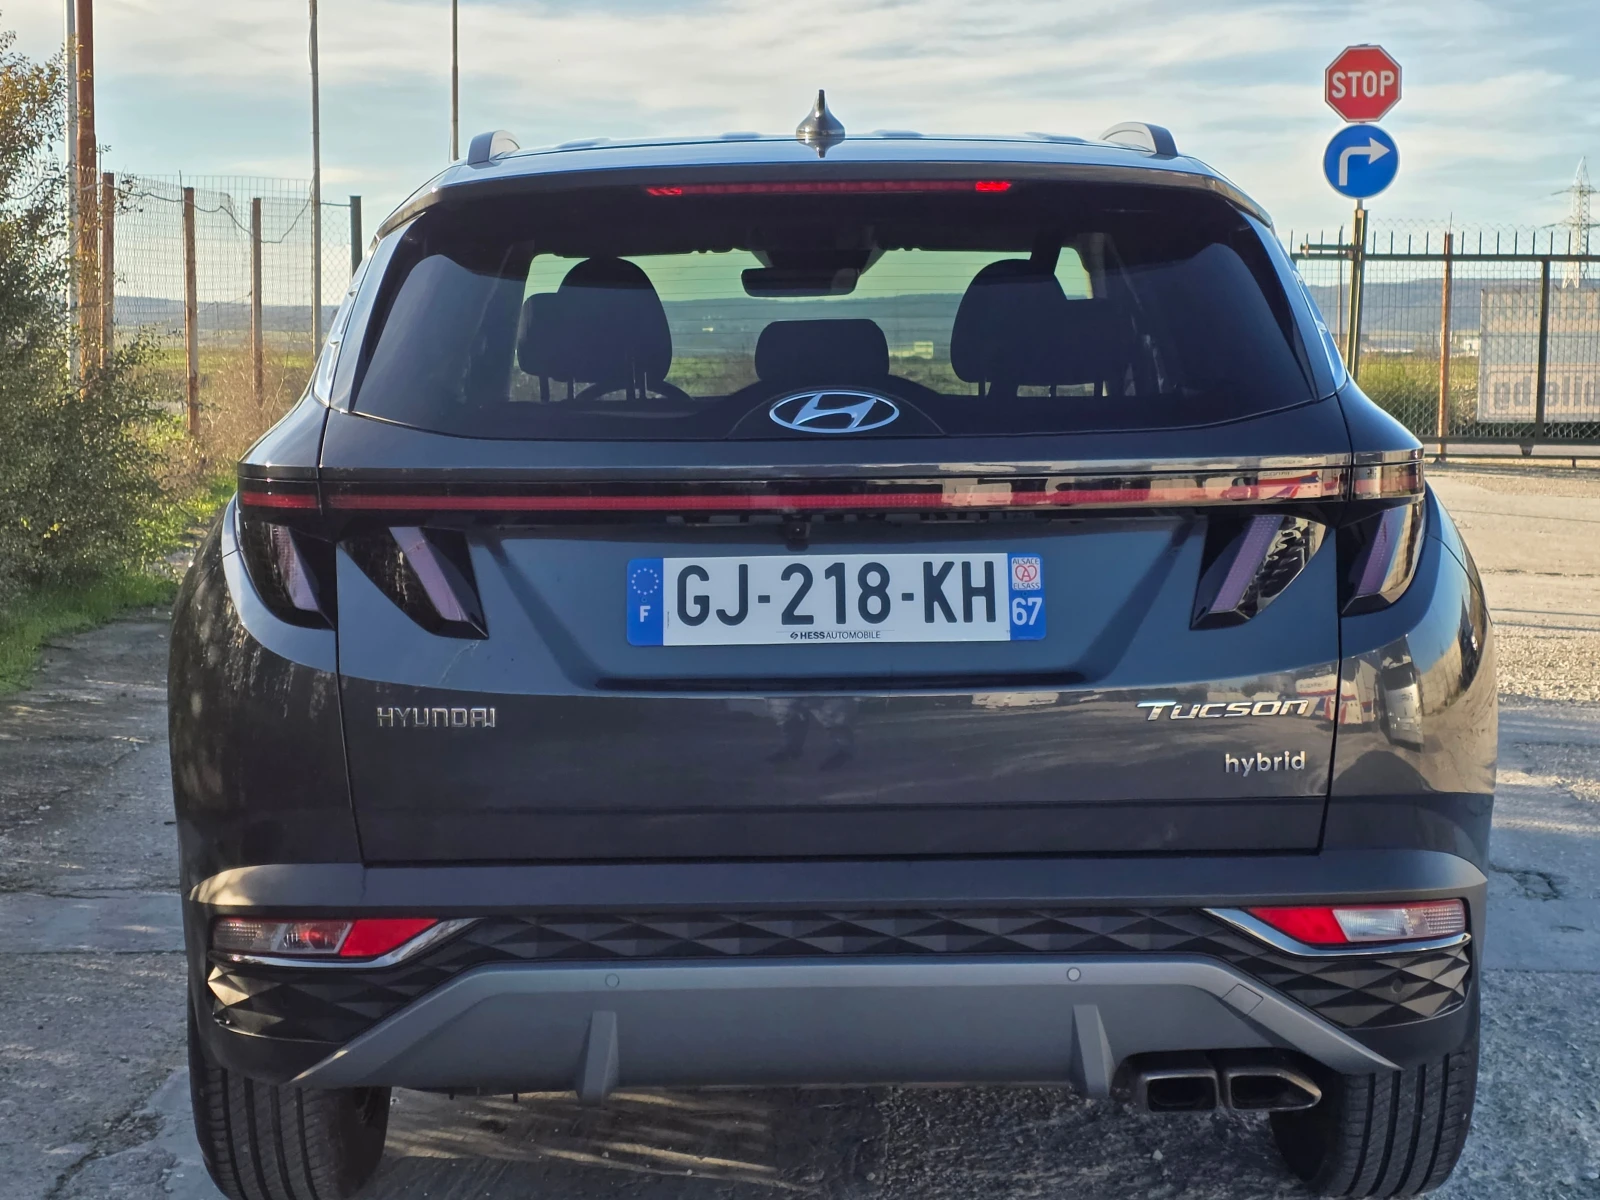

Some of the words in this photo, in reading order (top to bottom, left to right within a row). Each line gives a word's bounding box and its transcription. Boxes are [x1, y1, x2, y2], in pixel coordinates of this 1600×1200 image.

[1331, 70, 1395, 99] STOP
[677, 561, 997, 627] GJ-218-KH
[1013, 582, 1040, 590] ELSASS
[639, 605, 651, 622] F
[1011, 597, 1043, 626] 67
[376, 707, 496, 728] HYUNDAI
[1225, 751, 1306, 777] hybrid
